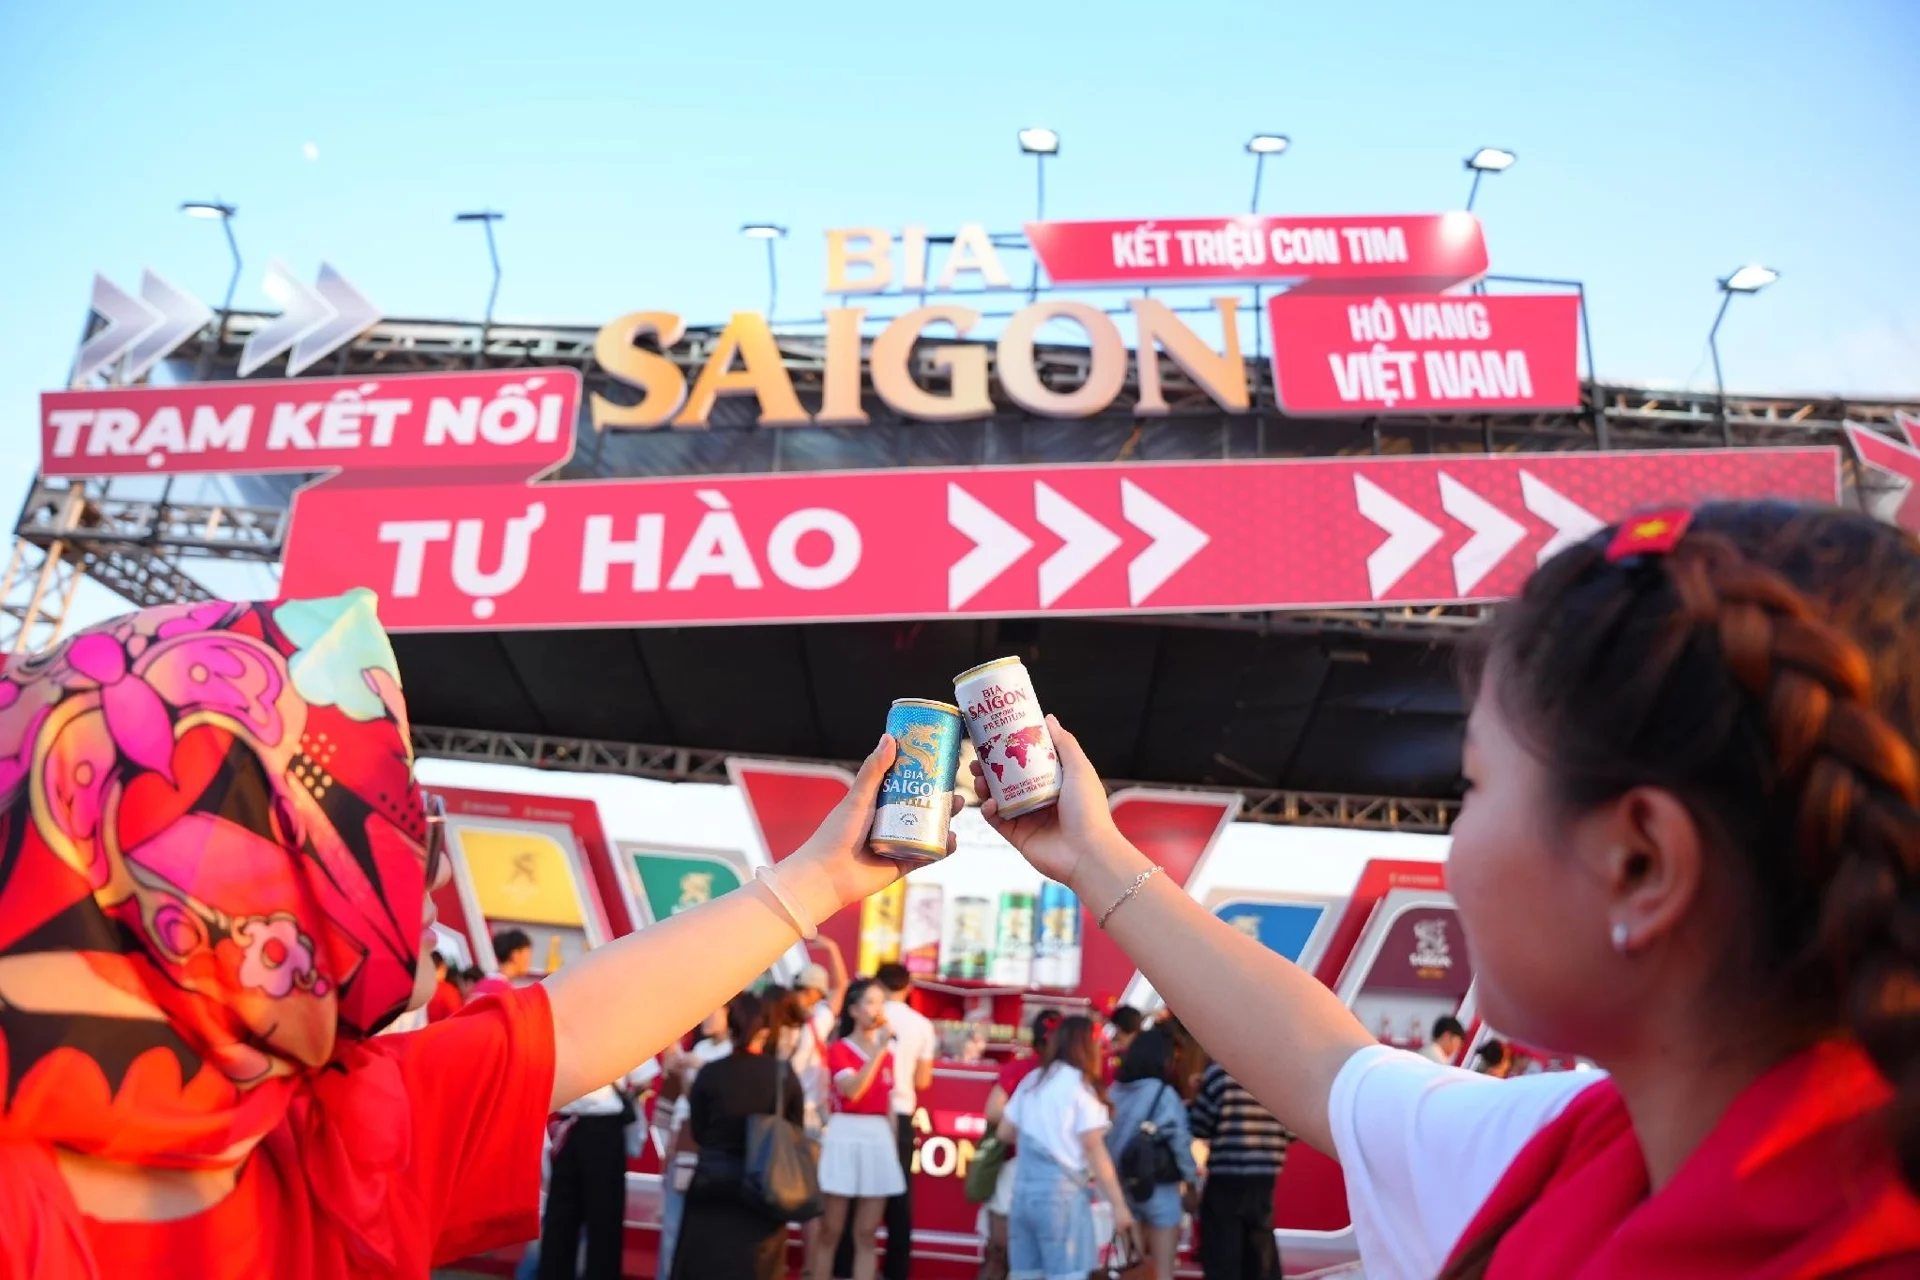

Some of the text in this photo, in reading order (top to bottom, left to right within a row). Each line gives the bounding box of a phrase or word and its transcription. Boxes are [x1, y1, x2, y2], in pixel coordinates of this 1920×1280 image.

[824, 222, 1012, 295] BIA
[1111, 221, 1409, 270] KẾT TRIỆU CON TIM
[1347, 296, 1492, 342] HÔ VANG
[590, 295, 1251, 429] SAIGON
[1328, 342, 1533, 408] VIỆT NAM
[47, 376, 564, 468] TRẠM KẾT NỐI
[378, 489, 863, 619] TỰ HÀO
[968, 688, 1028, 720] SAIGON
[982, 685, 1003, 698] BIA
[983, 711, 1026, 732] PREMIUM
[882, 779, 944, 797] SAIGO
[903, 769, 924, 780] BIA
